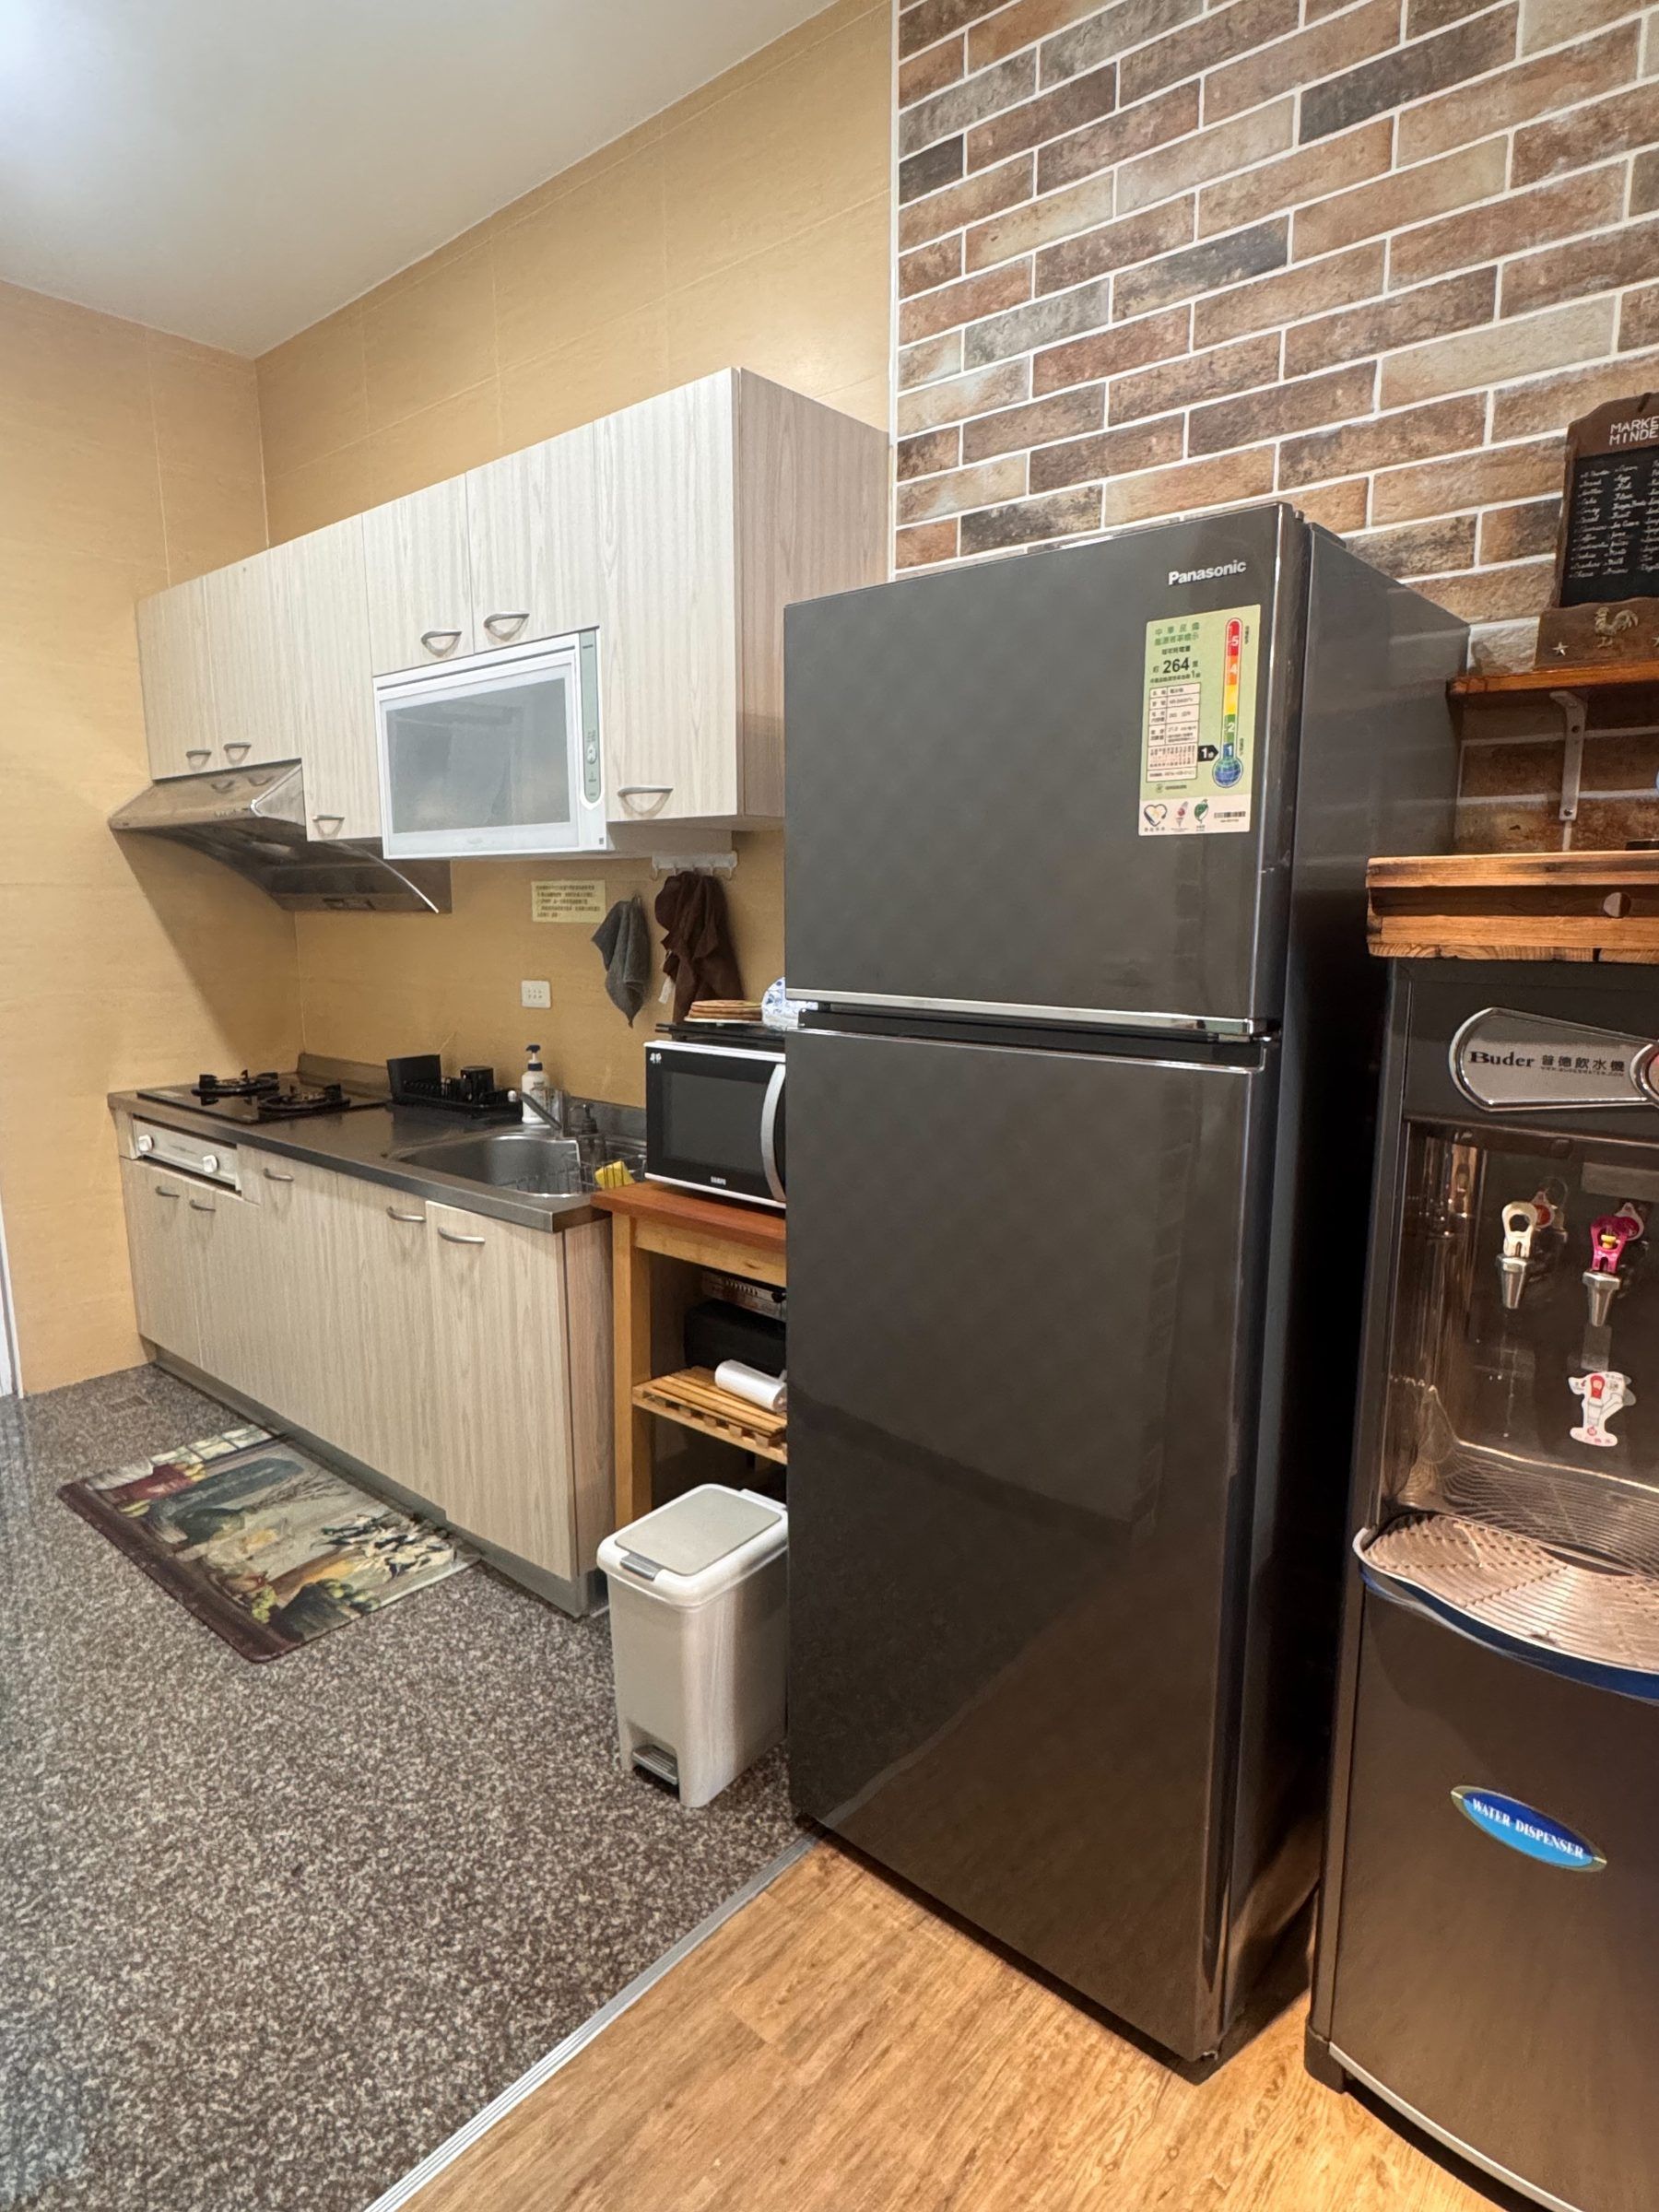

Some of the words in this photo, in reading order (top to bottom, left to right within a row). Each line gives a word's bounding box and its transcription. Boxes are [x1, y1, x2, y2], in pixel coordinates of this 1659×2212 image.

[1168, 559, 1247, 585] Panasonic
[1231, 635, 1240, 646] 5
[1162, 657, 1190, 674] 264
[1227, 722, 1235, 733] 2
[1469, 1051, 1535, 1067] Buder
[1542, 1054, 1625, 1072] 普德飲水機
[1472, 1797, 1511, 1828] WATER
[1514, 1818, 1584, 1859] DISPENSER
